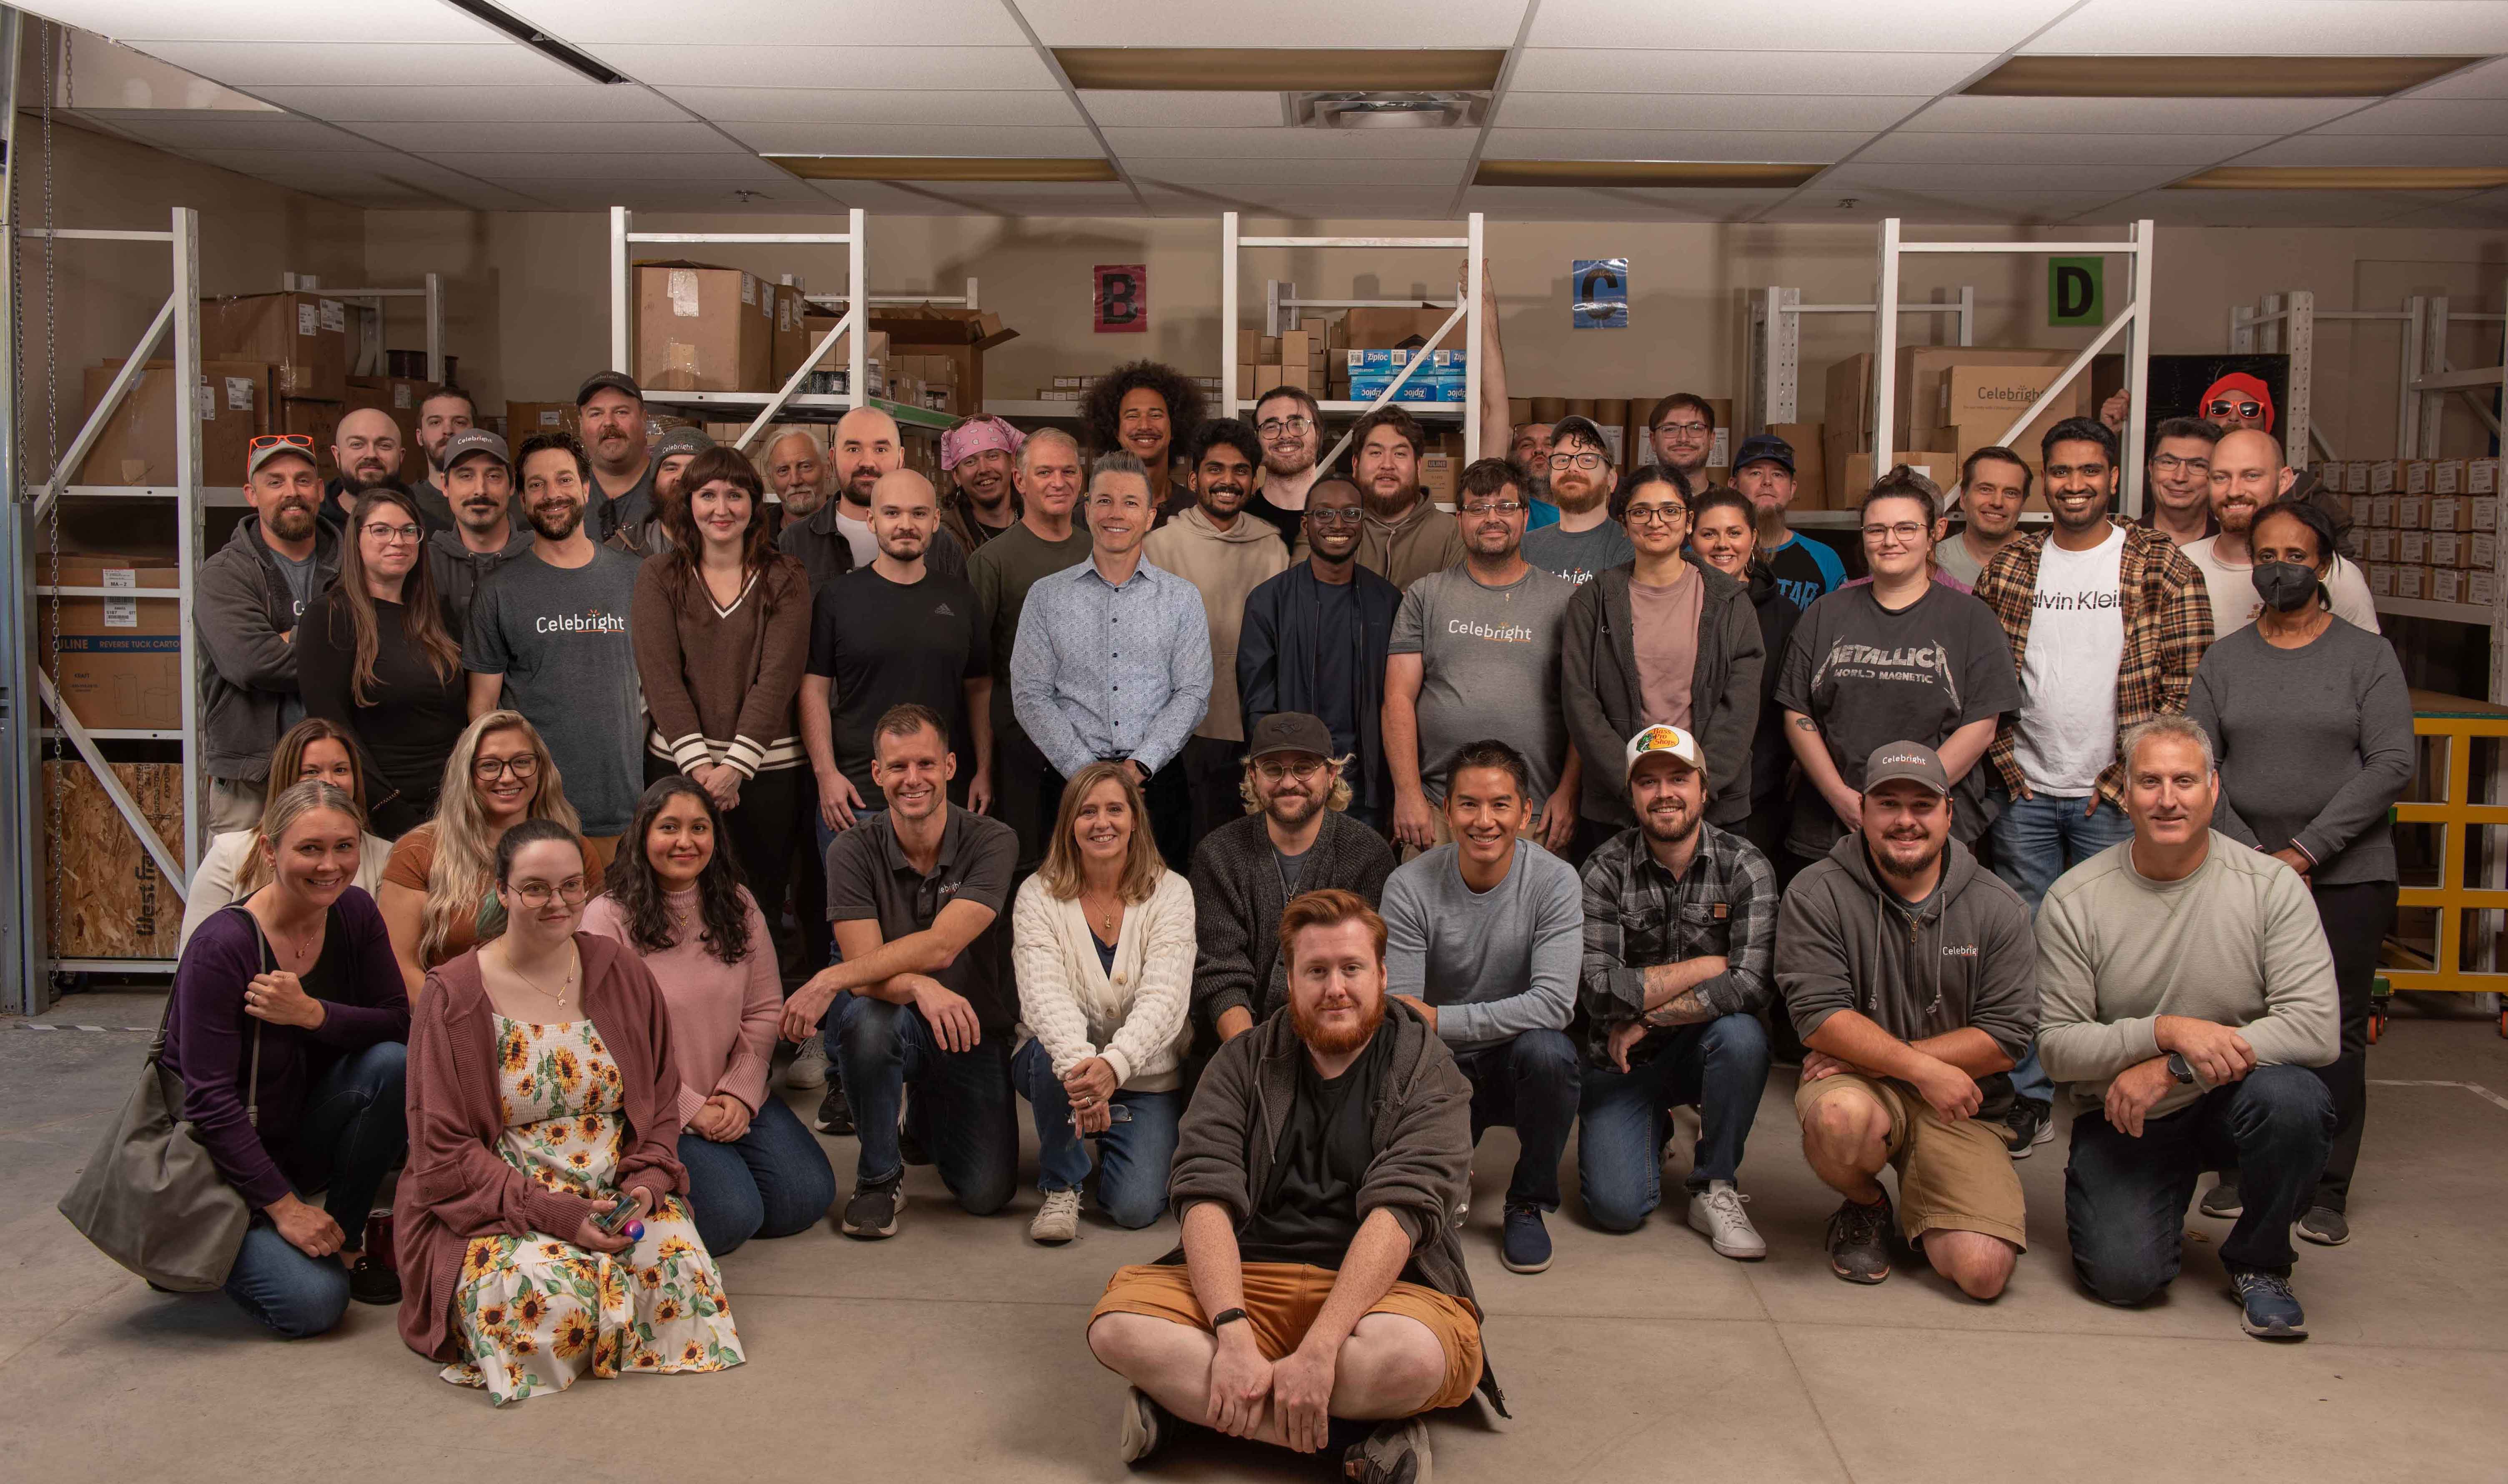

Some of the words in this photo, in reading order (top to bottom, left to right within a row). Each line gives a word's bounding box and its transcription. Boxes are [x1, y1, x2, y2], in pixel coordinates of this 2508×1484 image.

[1103, 273, 1137, 324] B
[1582, 269, 1618, 321] C
[2057, 266, 2094, 317] D
[1367, 353, 1388, 363] Ziploc
[1454, 353, 1467, 363] Zipl
[1361, 388, 1382, 397] Ziploc
[1404, 388, 1425, 397] Ziploc
[1978, 386, 2044, 403] Celebrigh
[458, 435, 493, 445] Celebright
[662, 444, 694, 453] Celebright
[1777, 577, 1819, 614] TAR
[2033, 590, 2073, 610] lvin
[537, 613, 624, 634] Celebright
[1449, 619, 1532, 642] Celebright
[1833, 668, 1875, 679] WORLD
[1879, 671, 1934, 684] MAGNETIC
[1882, 754, 1926, 765] Celebright
[135, 842, 155, 881] Fra
[938, 881, 961, 894] lebrigh
[135, 883, 155, 936] West
[1943, 945, 1979, 956] Celebrig
